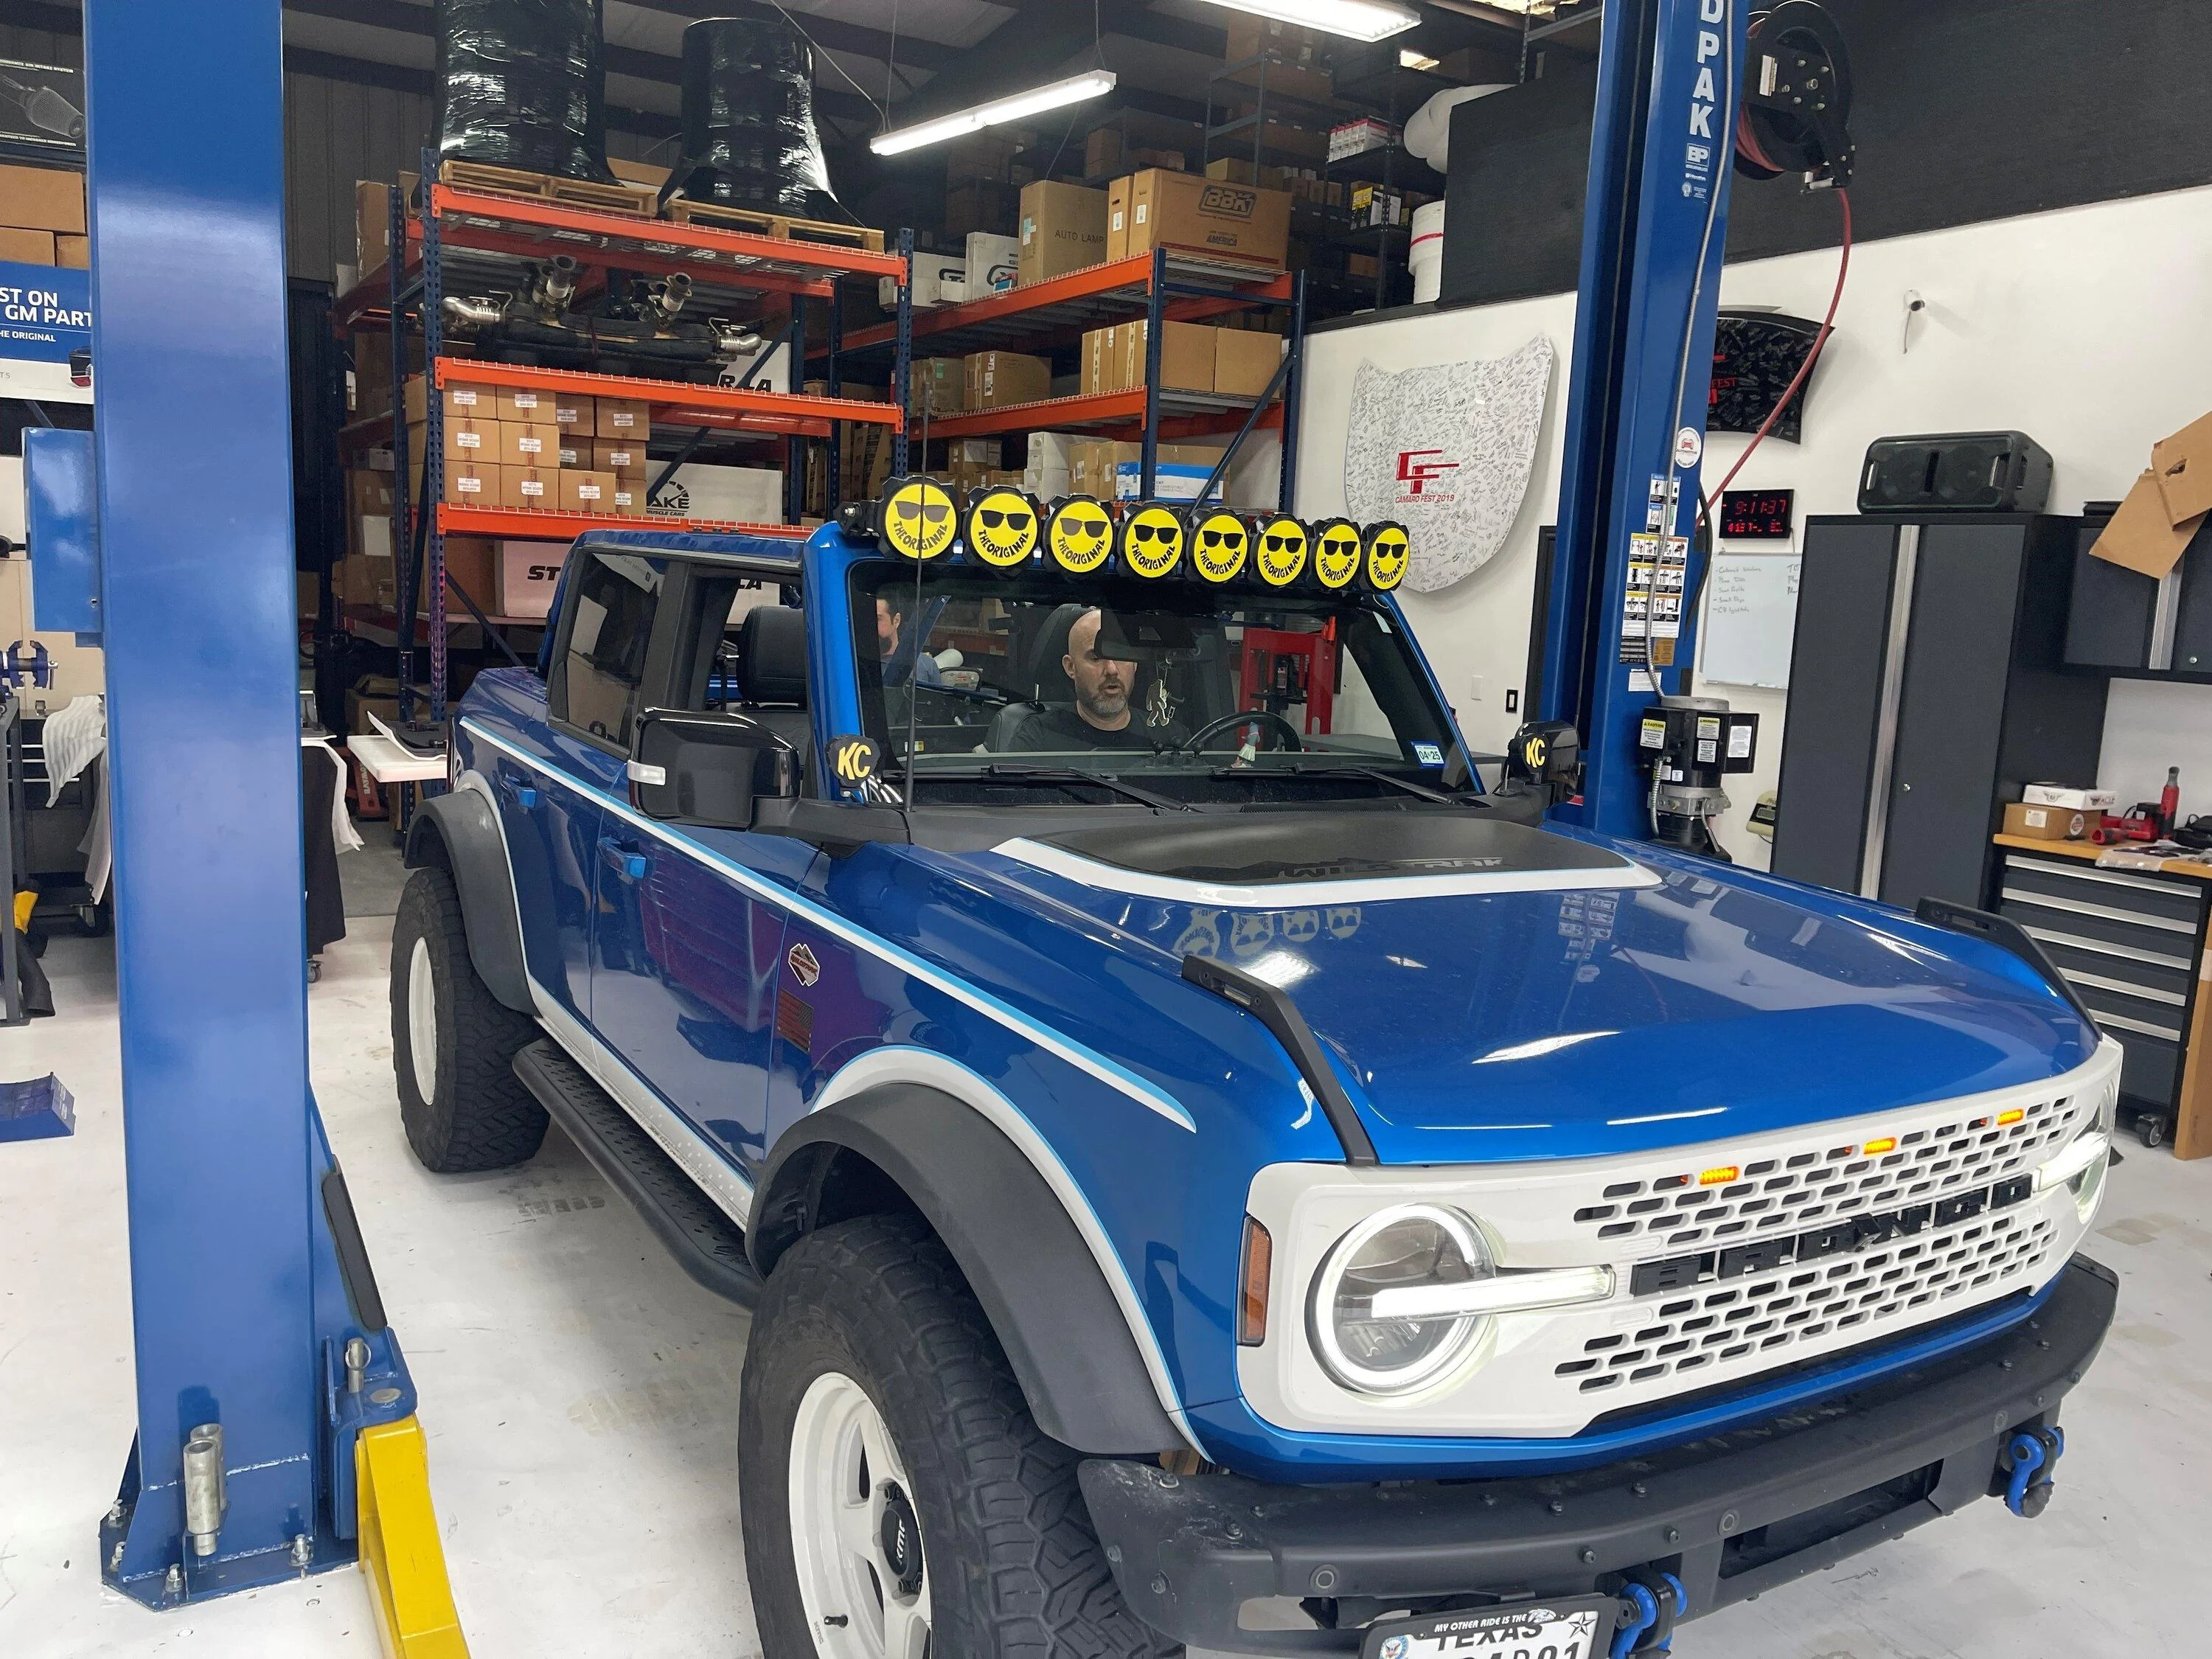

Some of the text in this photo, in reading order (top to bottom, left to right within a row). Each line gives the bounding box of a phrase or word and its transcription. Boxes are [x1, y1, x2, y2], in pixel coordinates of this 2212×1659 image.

[1054, 229, 1104, 244] AUTO LAMP
[28, 290, 58, 308] ON
[5, 304, 38, 322] GM
[12, 330, 57, 343] ORIGINAL
[1395, 494, 1455, 504] CAMARO FEST 2019
[838, 742, 872, 780] KC
[1419, 751, 1441, 760] 04 25
[1526, 737, 1545, 768] KC
[1434, 1613, 1527, 1633] MY OTHER RIDE IS THE
[1438, 1623, 1543, 1652] TEXAS
